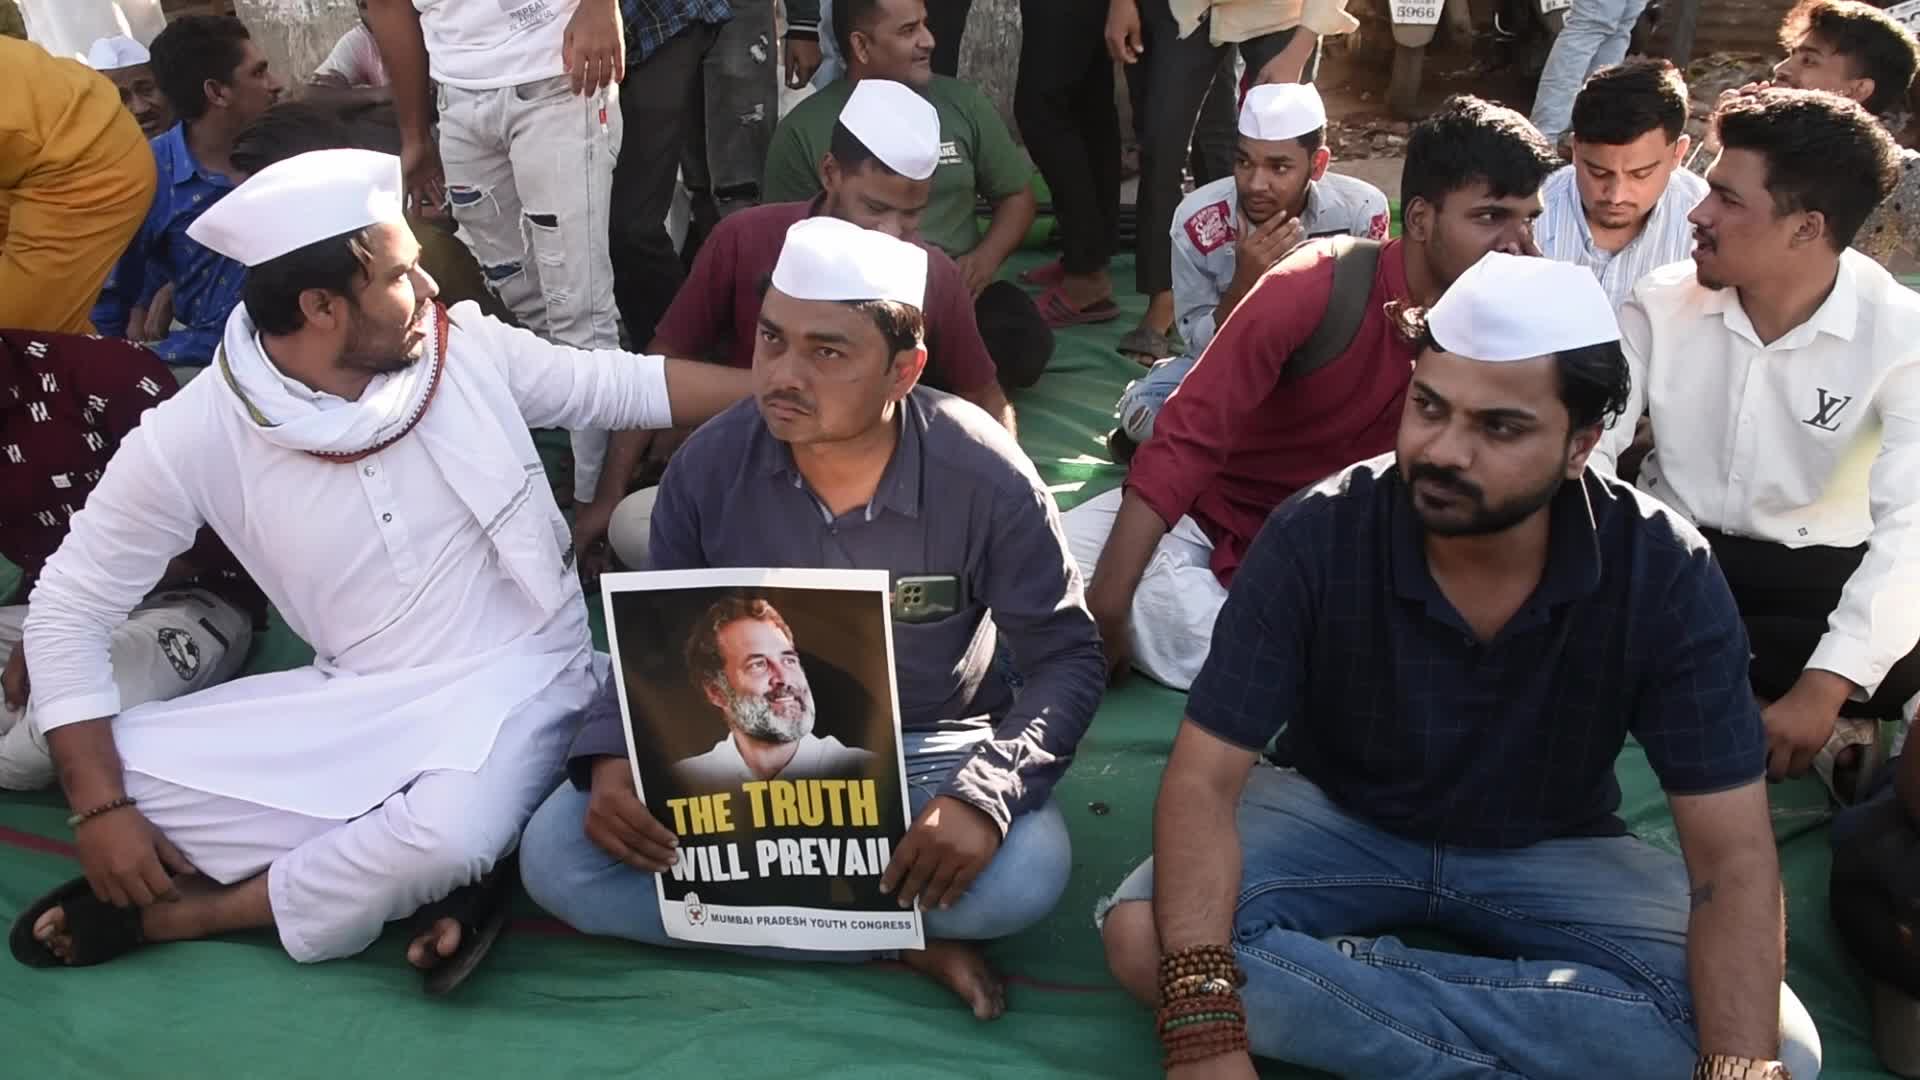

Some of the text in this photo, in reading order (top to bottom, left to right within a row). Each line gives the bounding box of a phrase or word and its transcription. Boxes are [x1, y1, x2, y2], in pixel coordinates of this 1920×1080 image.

[667, 779, 880, 836] THE TRUTH
[671, 843, 750, 882] WILL
[711, 913, 912, 931] MUMBAI PRADESH YOUTH CONGRESS
